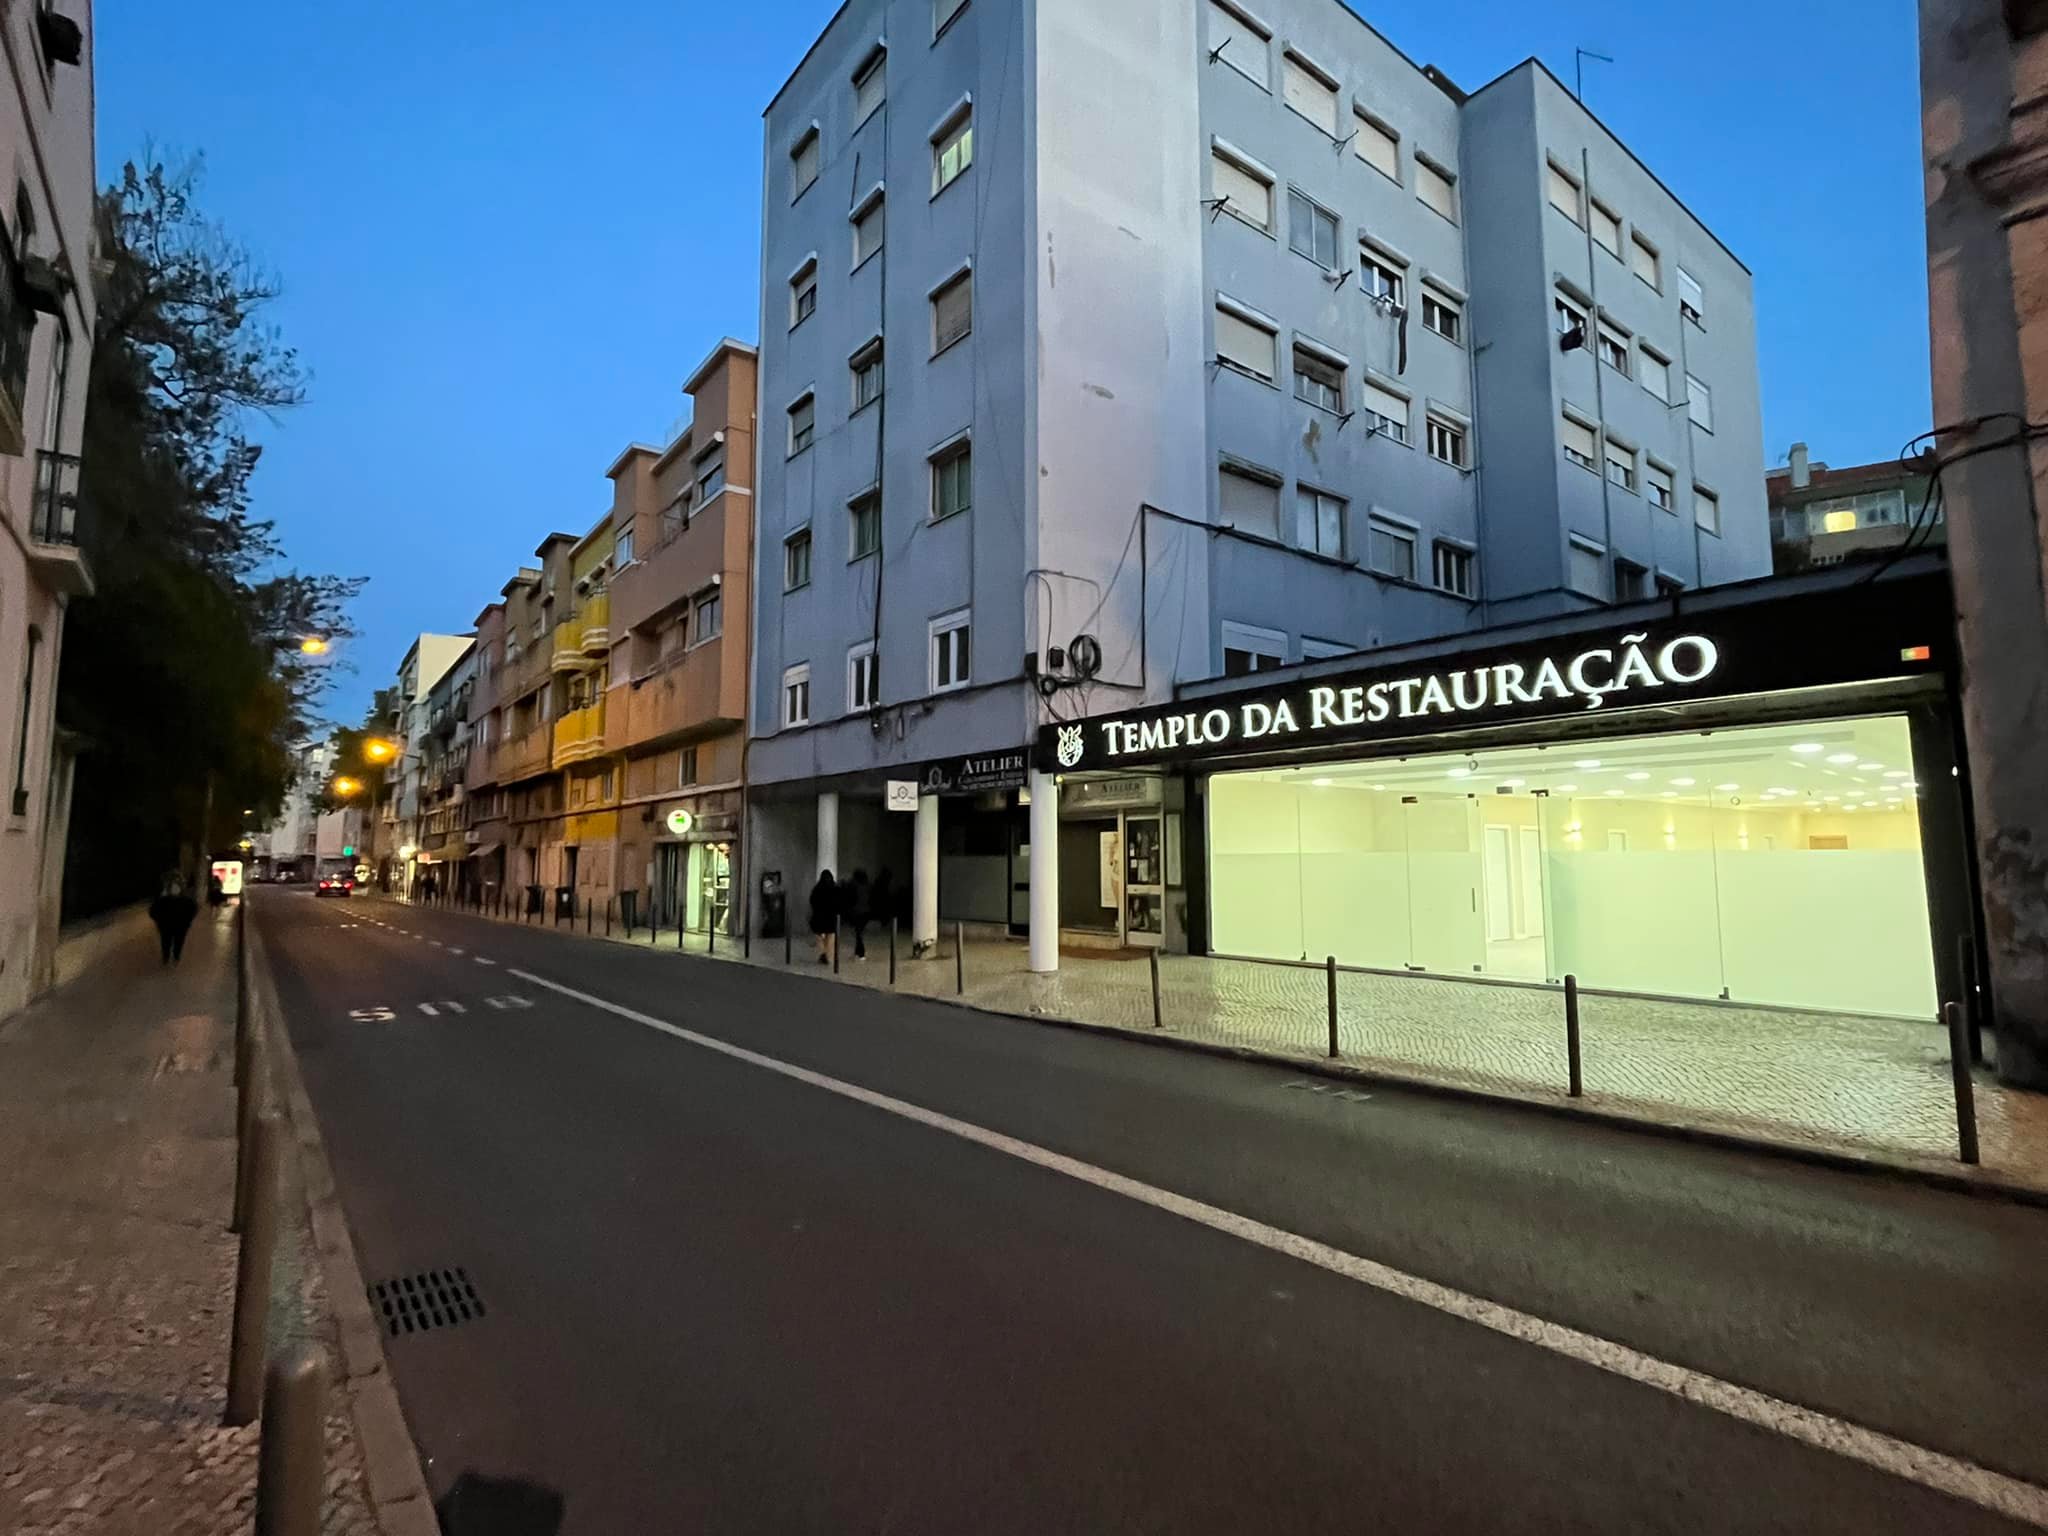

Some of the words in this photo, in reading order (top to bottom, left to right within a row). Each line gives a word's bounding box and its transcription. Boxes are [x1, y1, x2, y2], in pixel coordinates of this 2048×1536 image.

[1102, 709, 1231, 756] TEMPLO
[1241, 702, 1300, 739] DA
[1308, 632, 1719, 730] RESTAURAÇÃO
[961, 755, 1024, 775] ATELIER
